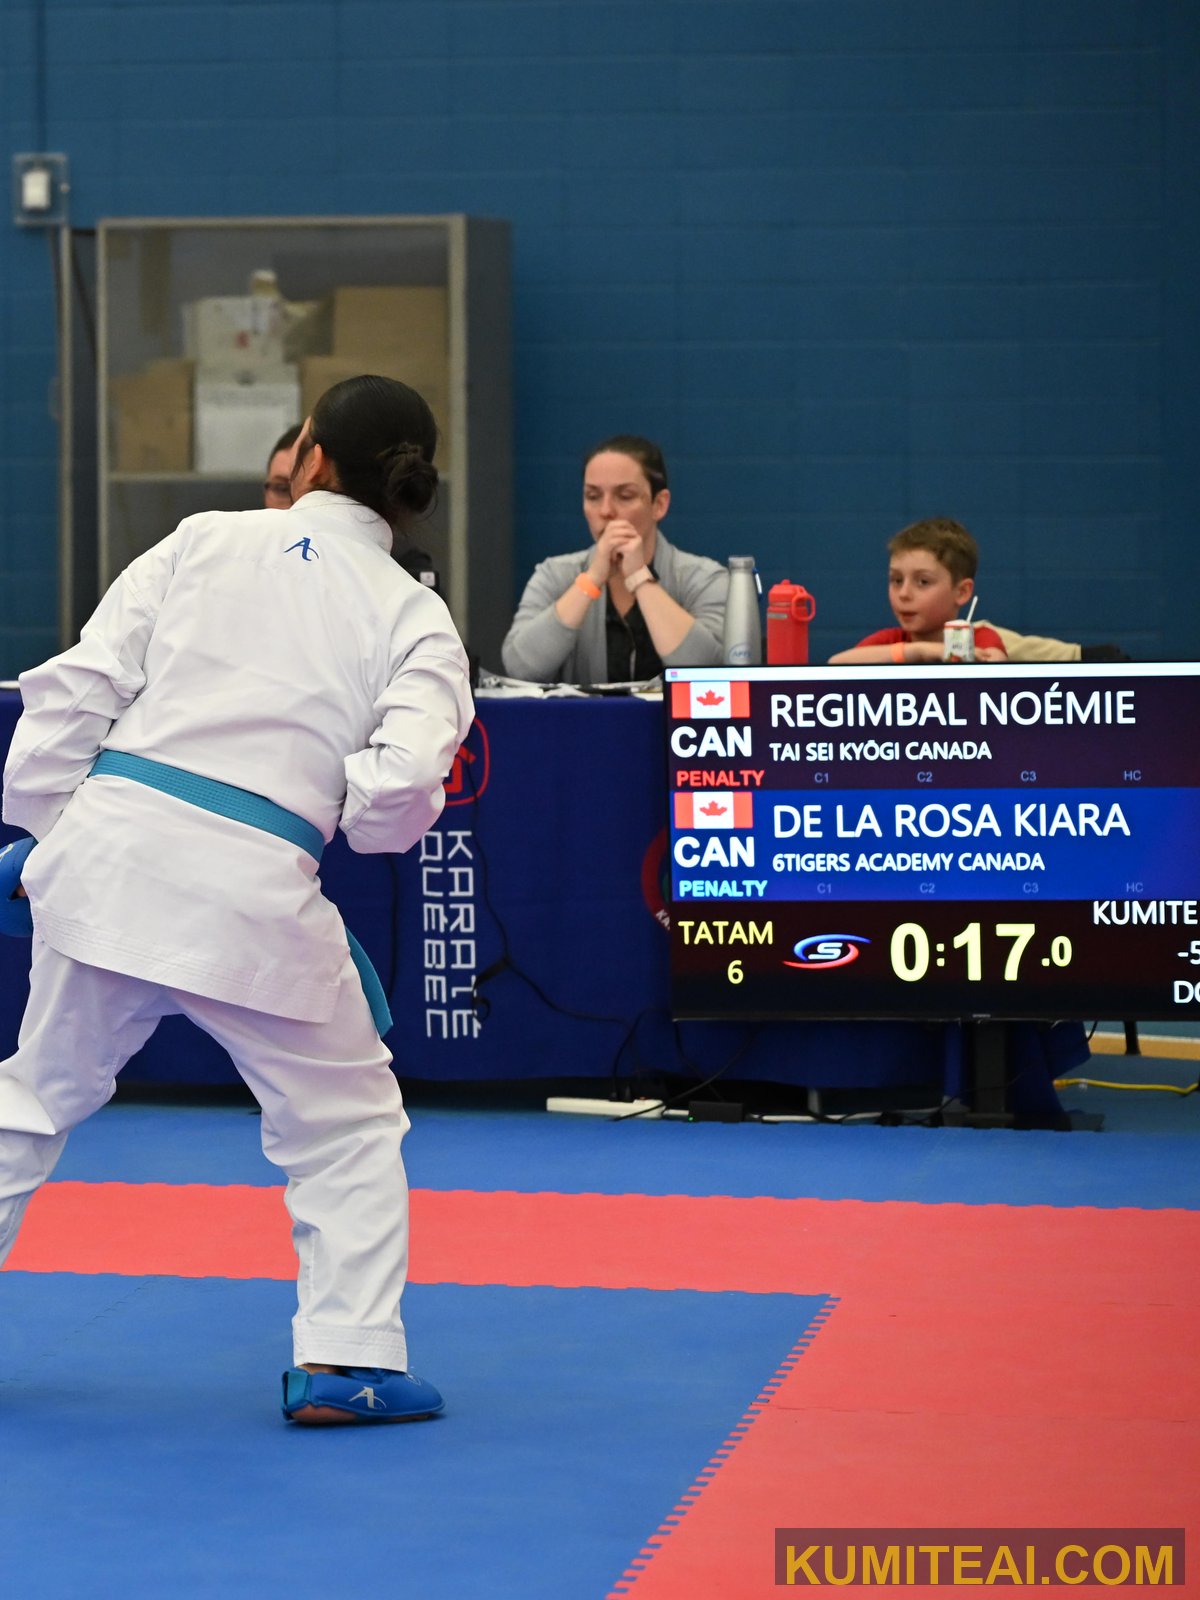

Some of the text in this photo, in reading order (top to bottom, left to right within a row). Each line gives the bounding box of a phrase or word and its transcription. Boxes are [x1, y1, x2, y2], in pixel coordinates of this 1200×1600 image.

[770, 681, 1136, 728] REGIMBAL NOÉMIE
[670, 725, 753, 758] CAN
[768, 742, 801, 762] TAI
[805, 742, 834, 762] SEI
[905, 741, 992, 761] CANADA
[676, 769, 765, 787] PENALTY
[814, 772, 829, 784] C1
[917, 771, 933, 783] C2
[1020, 770, 1037, 782] C3
[1123, 769, 1142, 781] HC
[773, 803, 1131, 839] DE LA ROSA KIARA
[673, 836, 755, 868] CAN
[772, 852, 1046, 872] 6TIGERS ACADEMY CANADA
[678, 880, 768, 898] PENALTY
[816, 882, 832, 894] C1
[919, 882, 936, 894] C2
[1022, 882, 1039, 894] C3
[1125, 881, 1144, 893] HC
[1093, 900, 1199, 926] KUMITE
[677, 920, 774, 946] TATAM
[727, 960, 744, 985] 6
